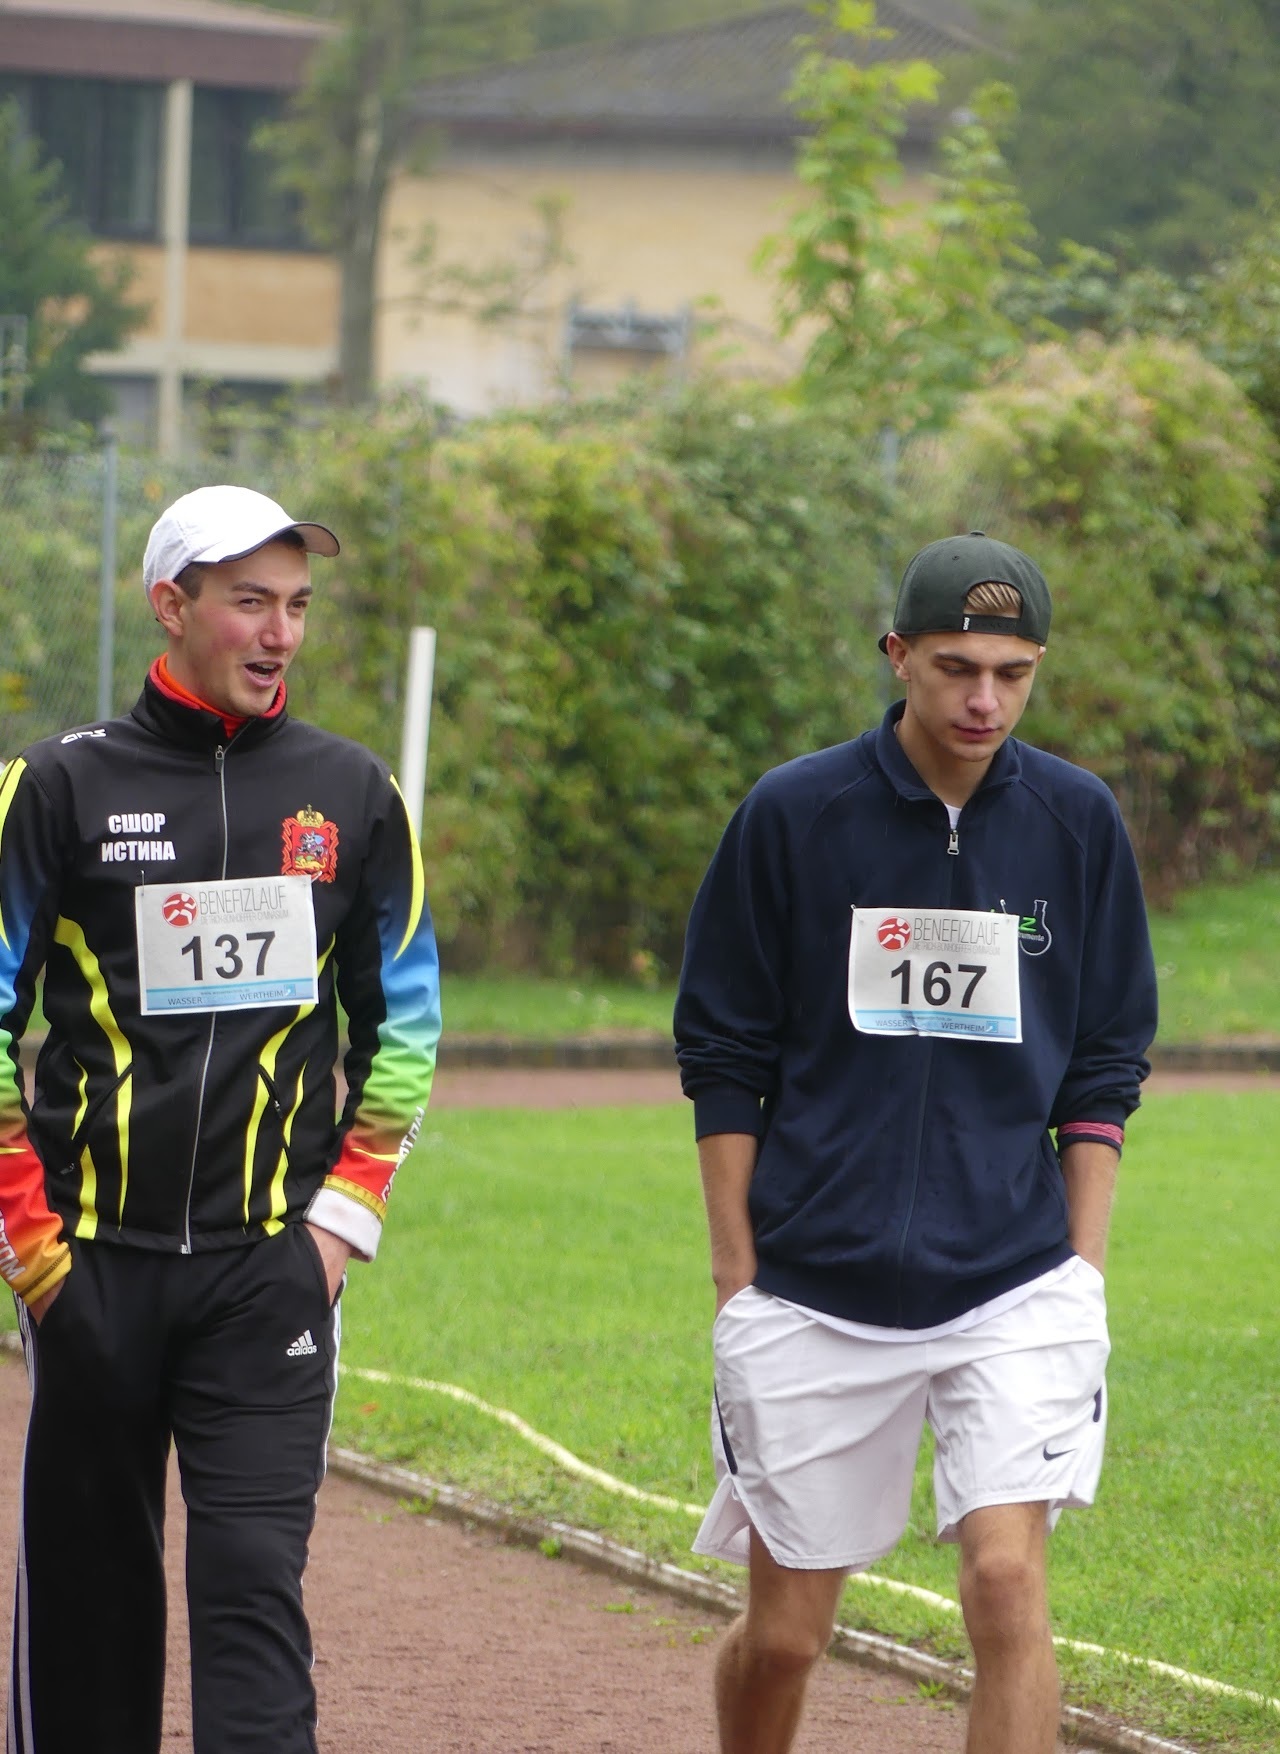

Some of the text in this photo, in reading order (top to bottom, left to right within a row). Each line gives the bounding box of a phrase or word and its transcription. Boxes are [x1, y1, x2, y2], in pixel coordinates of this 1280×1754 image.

[108, 813, 166, 834] СШОР
[102, 841, 176, 862] ИСТИНА
[200, 886, 287, 915] BENEFIZLAUF
[914, 917, 1000, 946] BENEFIZLAUF
[181, 931, 276, 981] 137
[891, 960, 987, 1008] 167
[168, 997, 203, 1006] WASSER
[240, 990, 284, 1001] WERTHEIM
[941, 1022, 985, 1032] WERTHEIM
[287, 1345, 318, 1356] adidas
